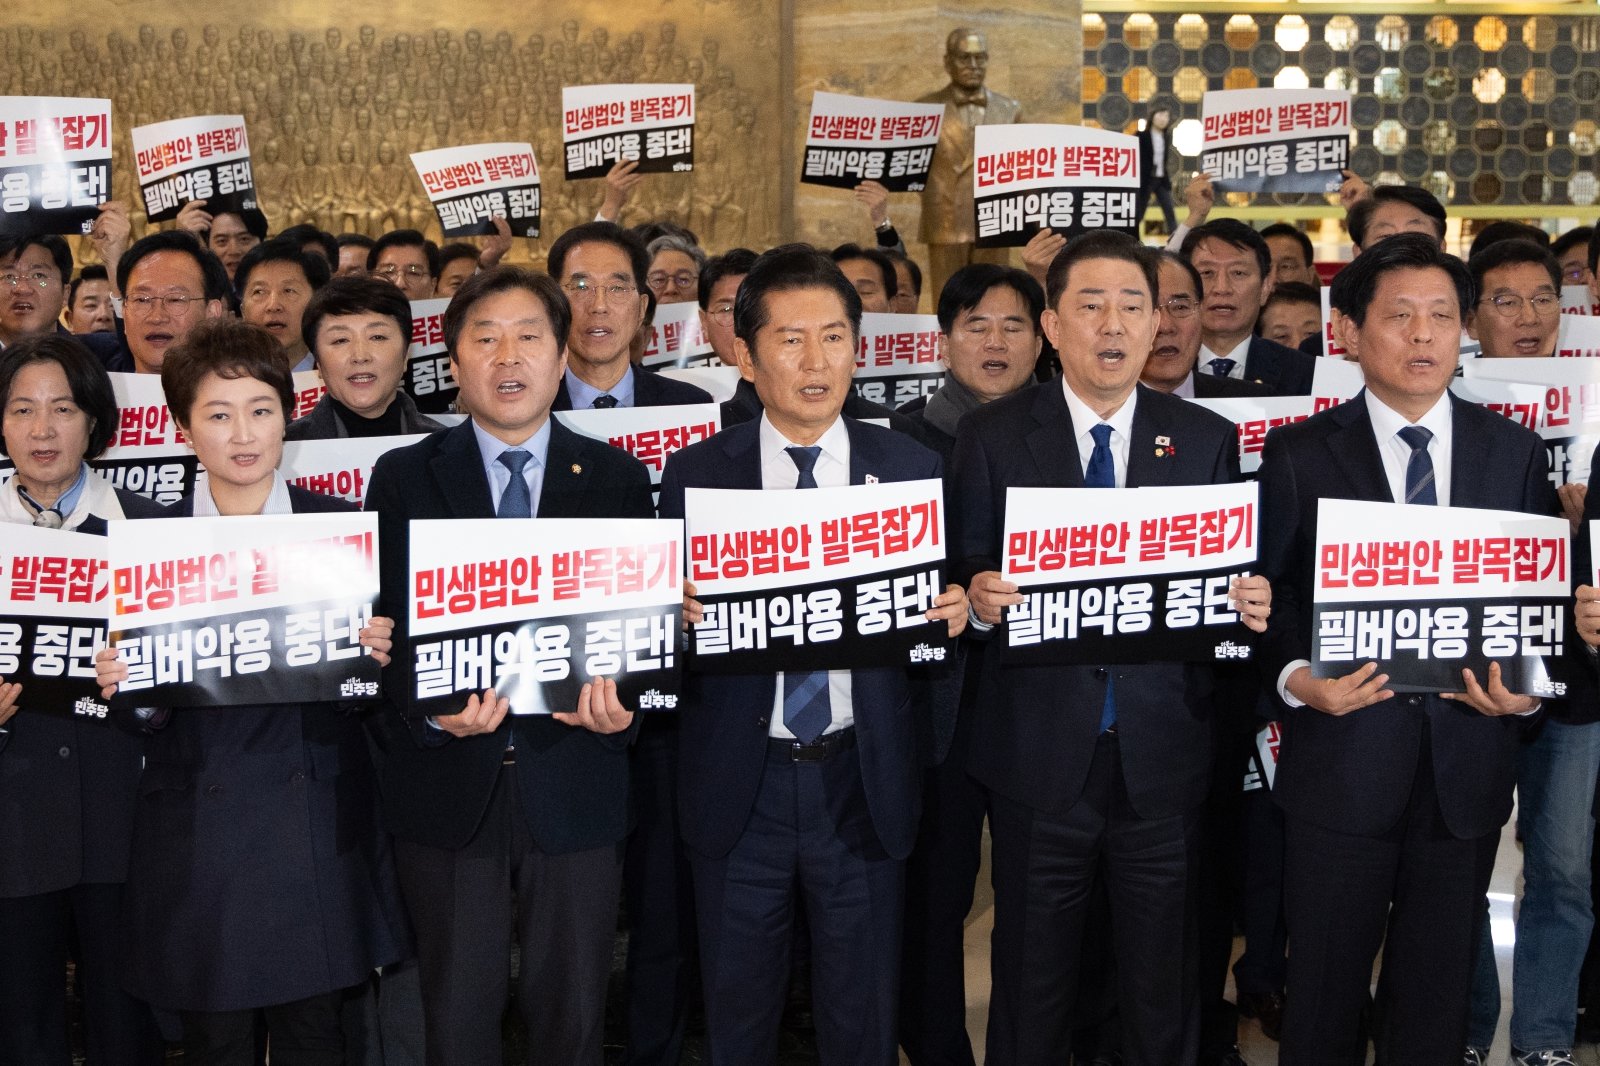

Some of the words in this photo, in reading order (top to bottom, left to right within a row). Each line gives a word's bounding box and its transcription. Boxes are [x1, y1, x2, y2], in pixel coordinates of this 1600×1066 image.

[15, 113, 107, 155] 발잡기
[566, 101, 625, 134] 민생법안
[630, 94, 691, 123] 발목잡기
[811, 115, 876, 140] 민생법안
[880, 114, 940, 140] 발목잡기
[1204, 106, 1272, 142] 민생법안
[1278, 101, 1347, 132] 발목잡기
[137, 136, 193, 176] 민생법안
[196, 125, 247, 158] 발목잡기
[566, 133, 641, 173] 필버악용
[646, 127, 691, 159] 중단!
[805, 149, 885, 179] 필버악용
[888, 147, 933, 177] 중단!
[977, 146, 1057, 187] 민생법안
[1063, 146, 1137, 178] 발목잡기
[1202, 144, 1288, 182] 필버악용
[1295, 139, 1347, 173] 중단!
[143, 169, 214, 216] 필버악용
[217, 161, 253, 195] 중단!
[422, 161, 484, 194] 민생법안
[484, 152, 536, 181] 발목잡기
[436, 192, 507, 231] 필버악용
[507, 187, 540, 219] 중단!
[977, 191, 1074, 238] 필버악용
[1081, 191, 1136, 228] 중단!
[874, 331, 943, 367] 발목잡
[691, 524, 811, 581] 민생법안
[821, 499, 939, 567] 발목잡기
[1008, 521, 1130, 575] 민생법안
[1139, 503, 1253, 563] 발목잡기
[114, 550, 238, 616] 민생법안
[415, 555, 542, 619] 민생법안
[552, 540, 677, 601] 발목잡기
[1321, 539, 1443, 589] 민생법안
[1452, 537, 1566, 584] 발목잡기
[693, 588, 843, 655] 필버악용
[855, 569, 941, 636] 중단!
[1006, 582, 1153, 647] 필버악용
[1318, 606, 1469, 662] 필버악용
[1481, 605, 1564, 658] 중단!
[116, 618, 271, 692] 필버악용
[284, 603, 373, 667] 중단!
[415, 624, 571, 699] 필버악용
[584, 613, 675, 677] 중단!
[909, 646, 947, 663] 민주당
[1214, 645, 1251, 659] 민주당
[74, 700, 109, 718] 민주당
[340, 681, 379, 697] 민주당
[639, 694, 678, 709] 민주당
